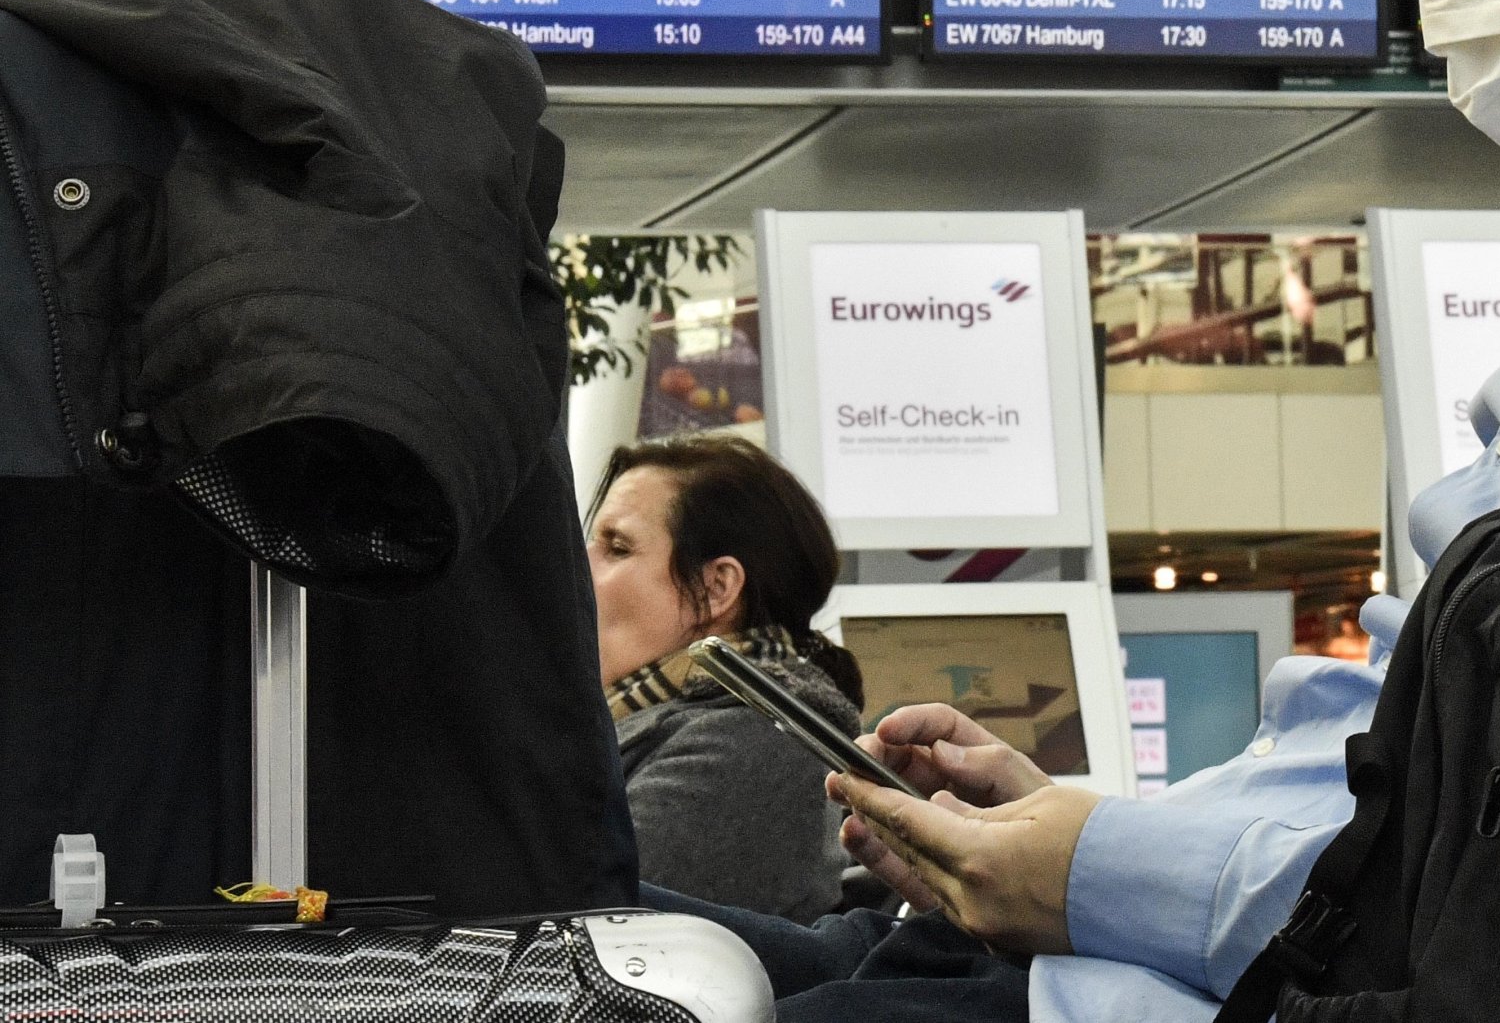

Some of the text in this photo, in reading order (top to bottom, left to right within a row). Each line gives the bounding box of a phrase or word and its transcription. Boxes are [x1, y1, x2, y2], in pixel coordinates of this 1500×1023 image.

[947, 24, 1343, 49] EW 7067 Hamburg 17:30 159-170 A
[831, 296, 991, 328] Eurowings
[837, 404, 1019, 428] Self-Check-in
